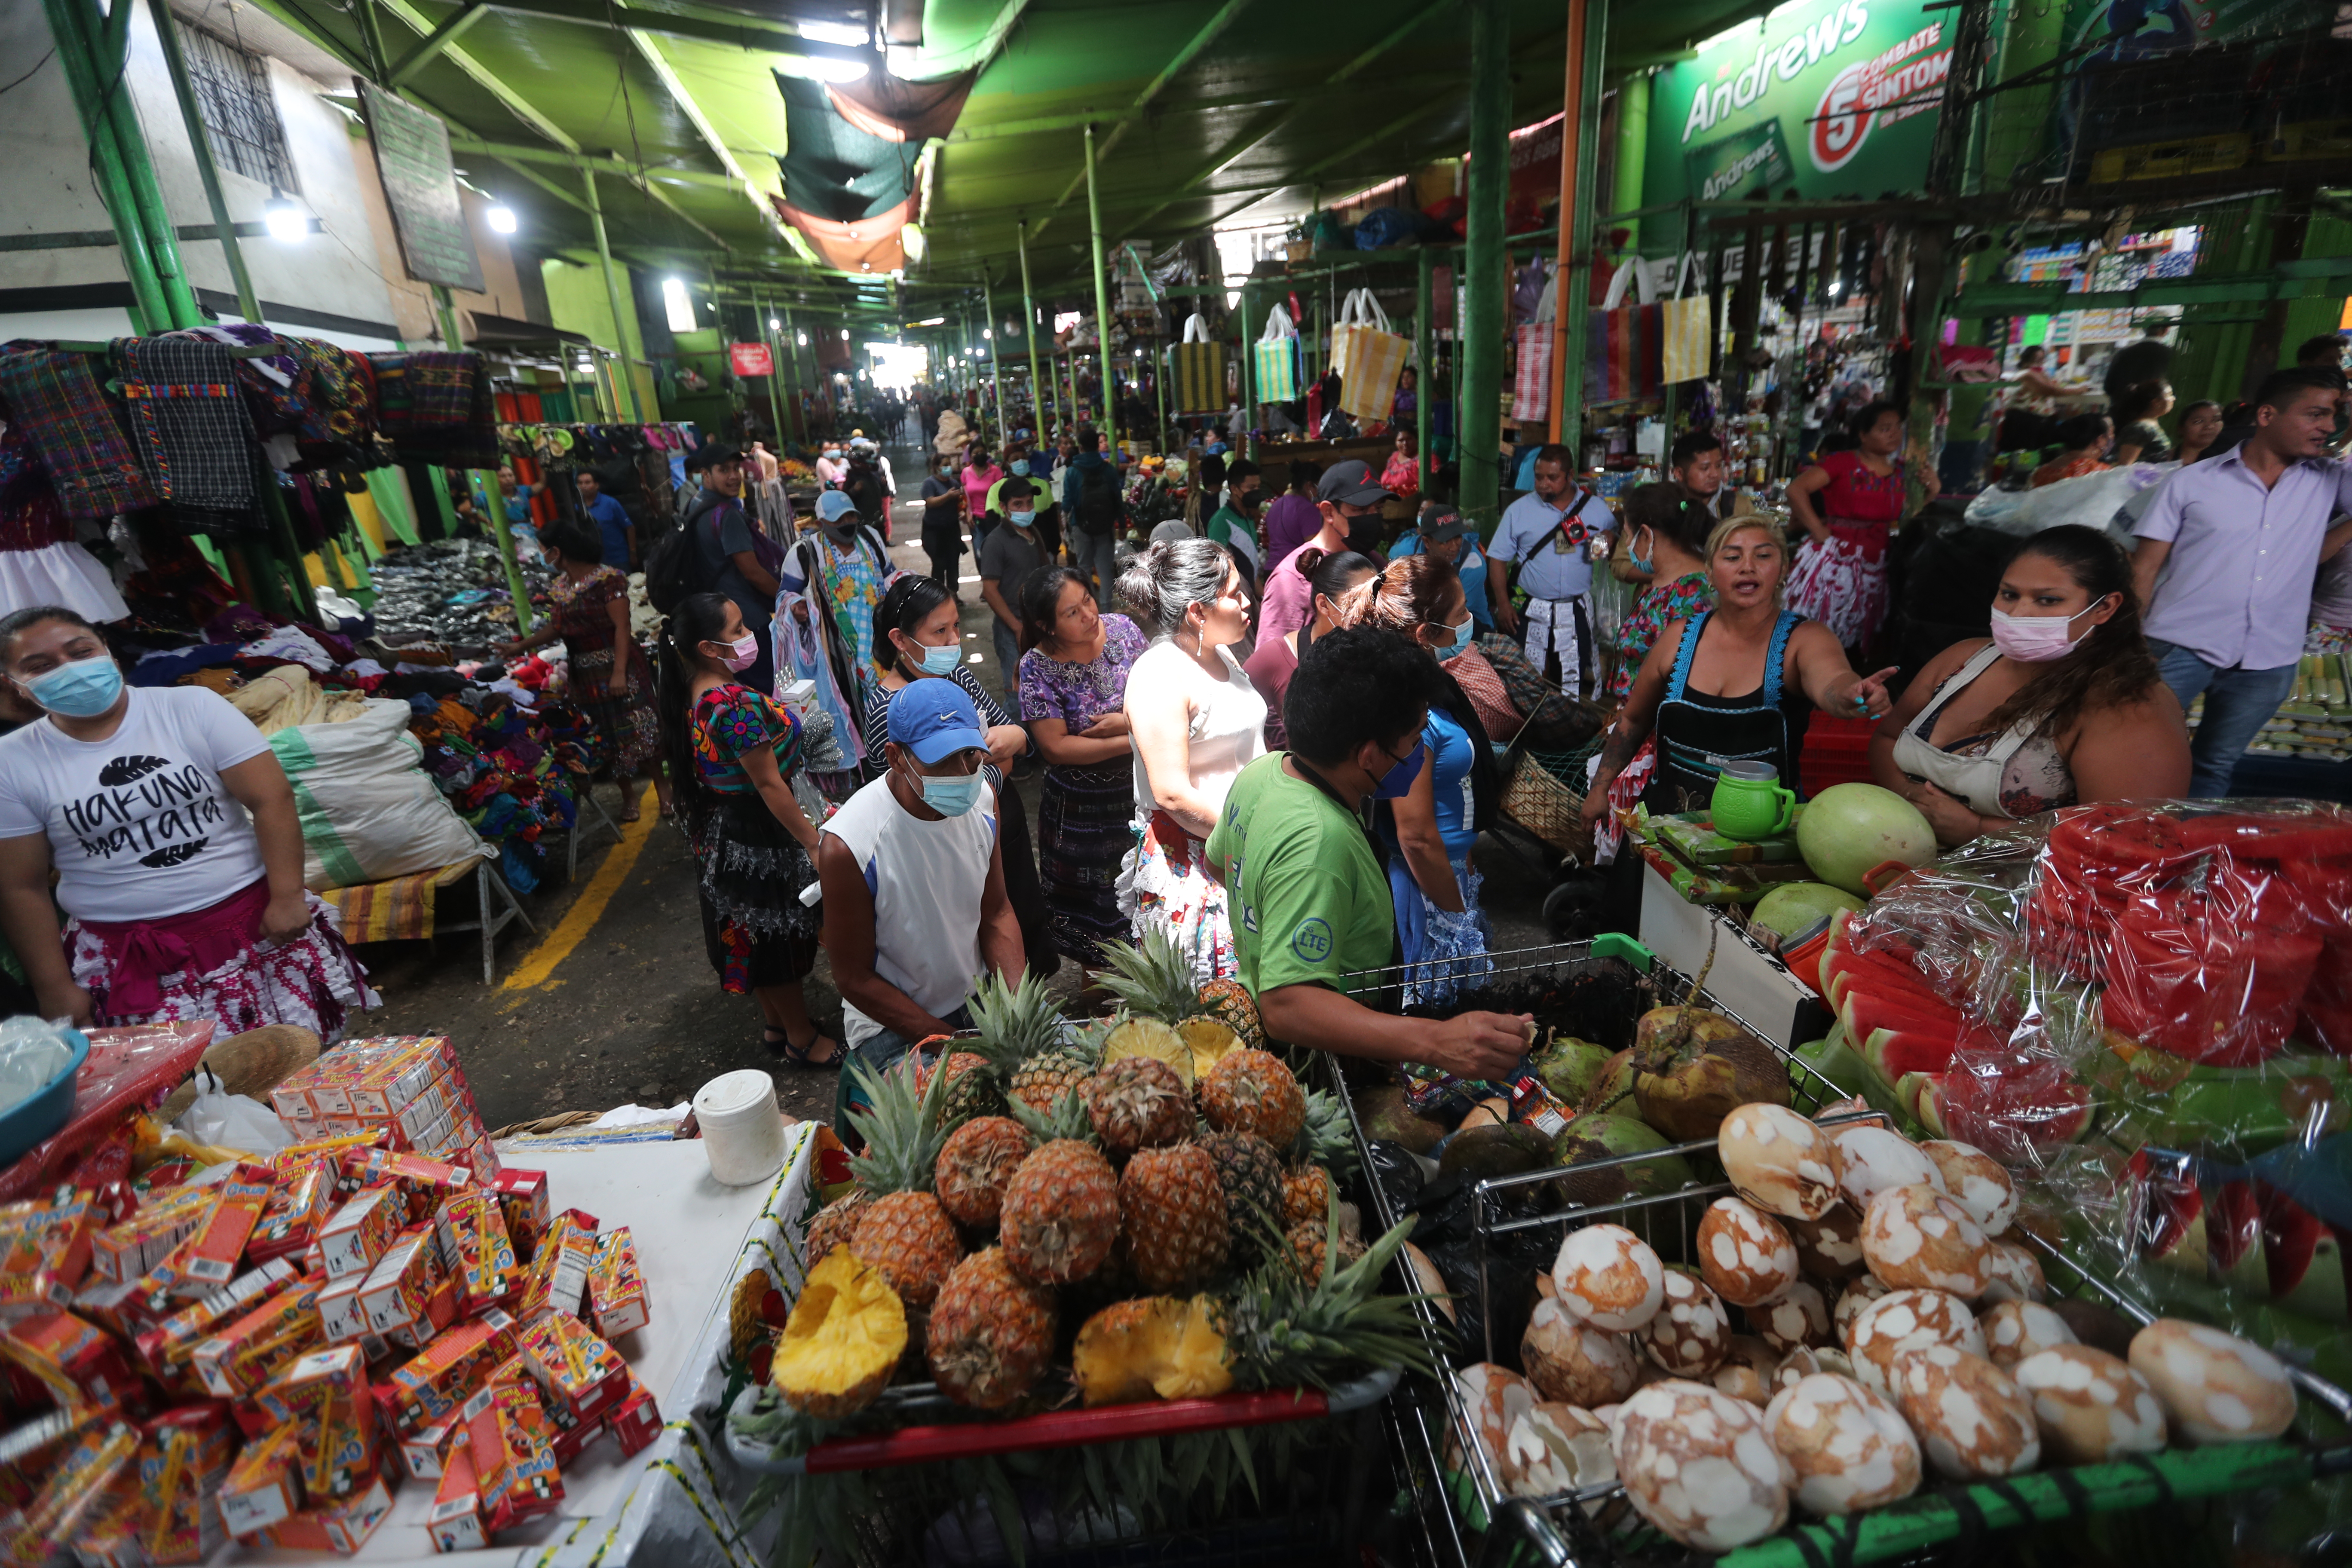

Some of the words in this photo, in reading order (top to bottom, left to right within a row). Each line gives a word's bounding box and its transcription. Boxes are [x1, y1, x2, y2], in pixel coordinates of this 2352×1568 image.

[1681, 0, 1868, 144] Andrews
[1859, 21, 1942, 84] COMBATE
[1862, 48, 1954, 110] SINTOM
[1826, 74, 1860, 152] 5
[1703, 138, 1775, 201] Andrews
[1300, 931, 1327, 952] LTE
[496, 1386, 523, 1401] Punch
[509, 1391, 537, 1406] Citrus
